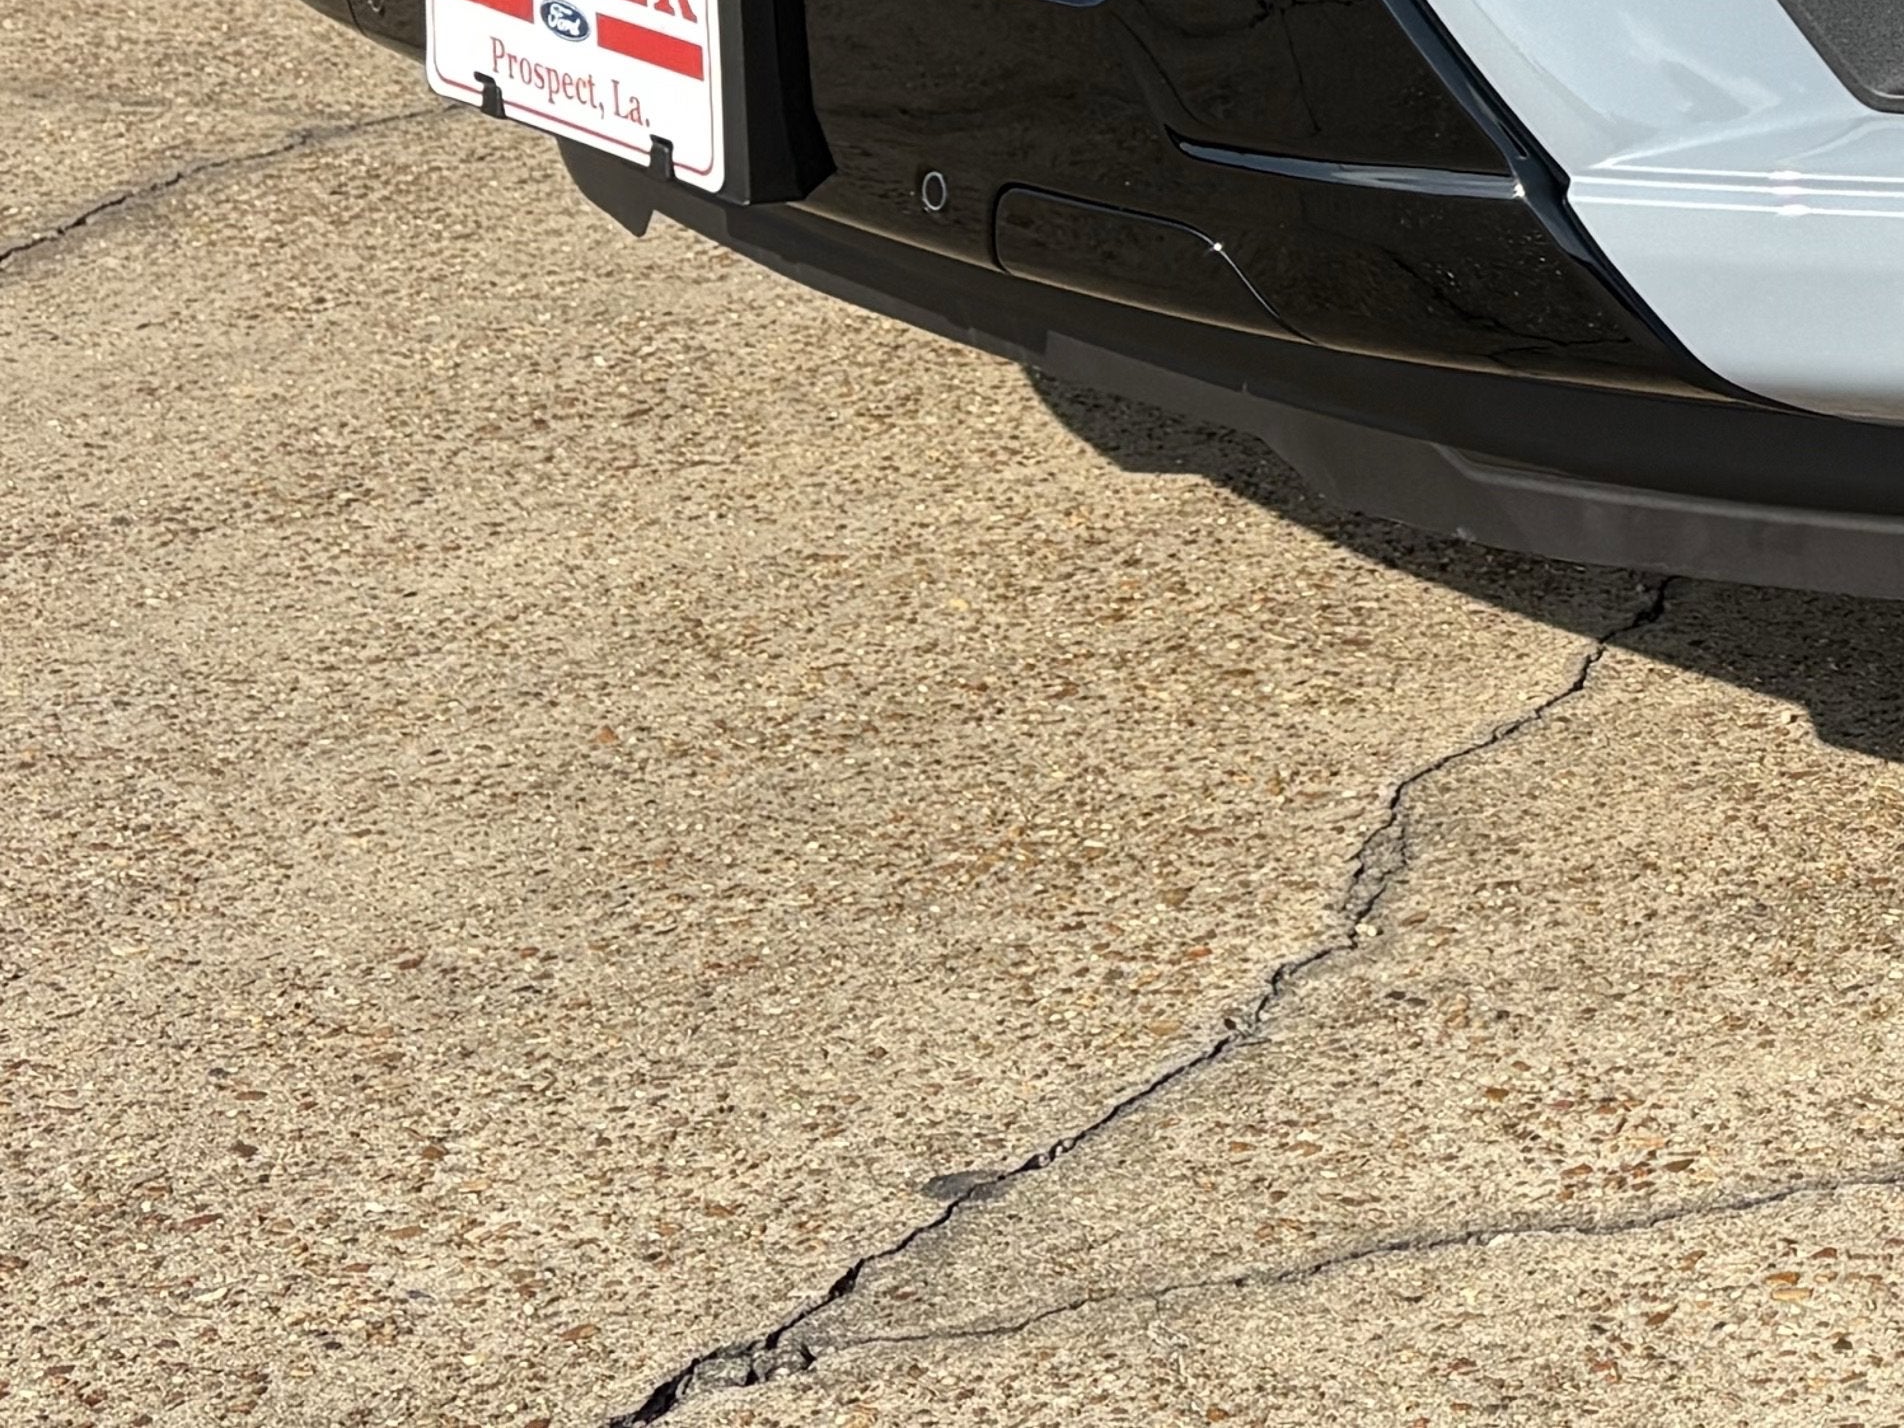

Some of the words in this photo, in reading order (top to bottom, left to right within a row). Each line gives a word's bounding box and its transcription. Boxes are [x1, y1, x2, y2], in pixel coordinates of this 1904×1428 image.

[545, 3, 582, 38] Ford
[490, 37, 605, 119] Prospect,
[611, 80, 651, 127] La.
